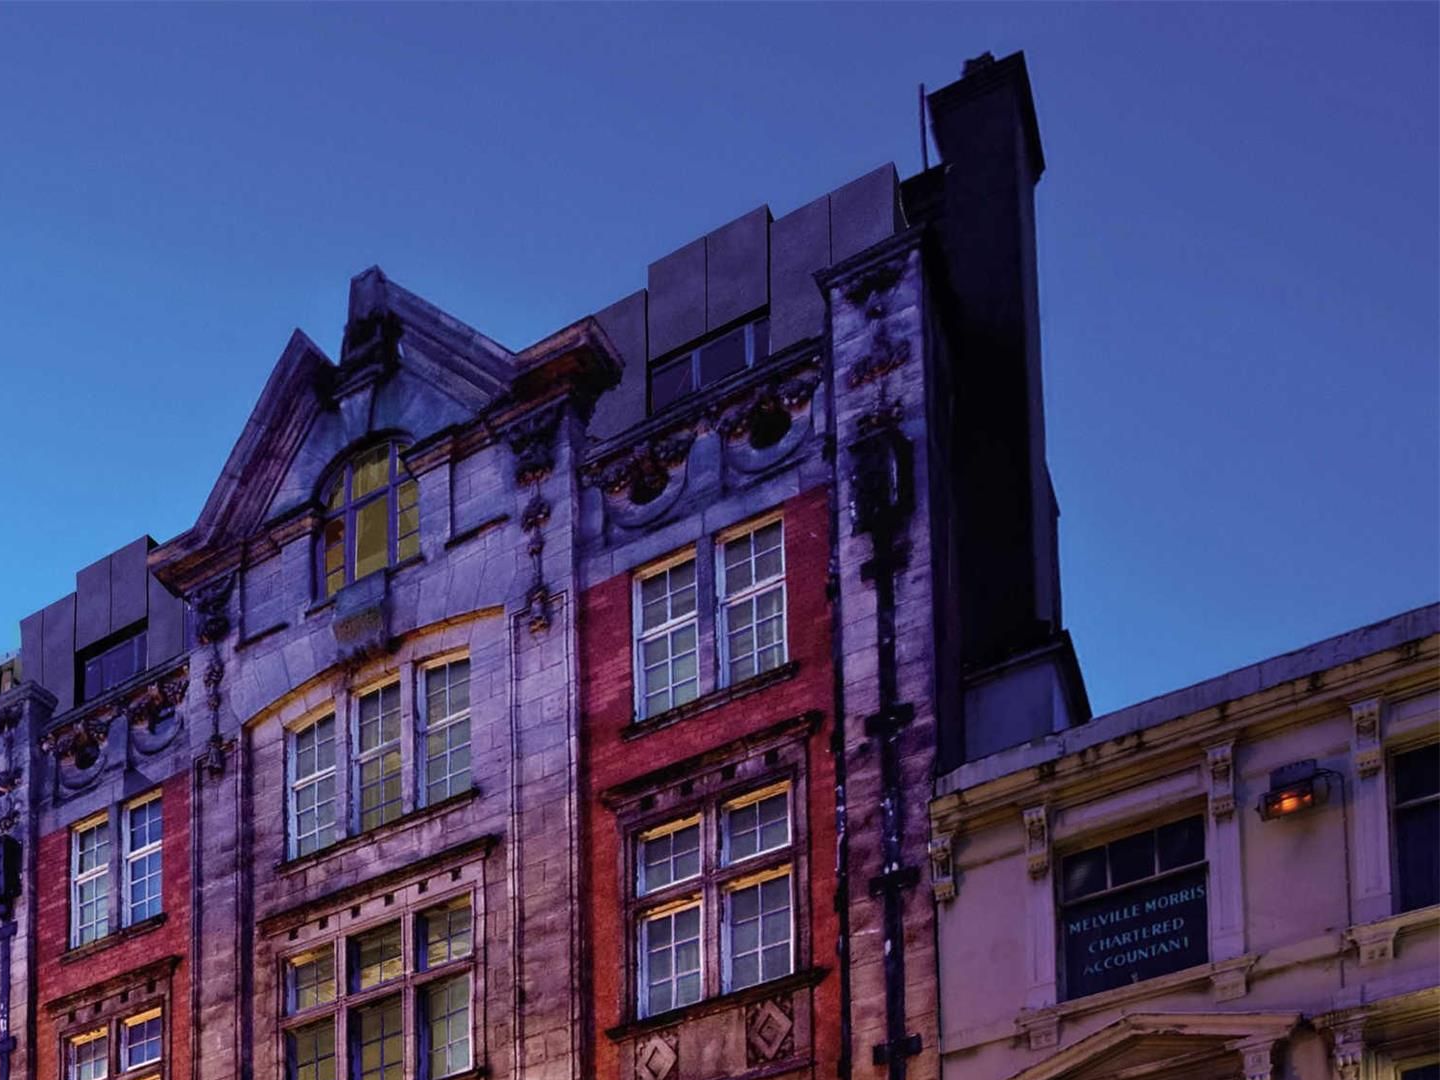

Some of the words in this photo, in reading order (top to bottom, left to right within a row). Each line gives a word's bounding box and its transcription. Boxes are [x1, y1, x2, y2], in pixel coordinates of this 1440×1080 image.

[1069, 904, 1141, 935] MELVILLE
[1145, 885, 1206, 913] MORRIS
[1088, 917, 1185, 953] CHARTERED
[1083, 936, 1190, 976] ACCOUNTANT
